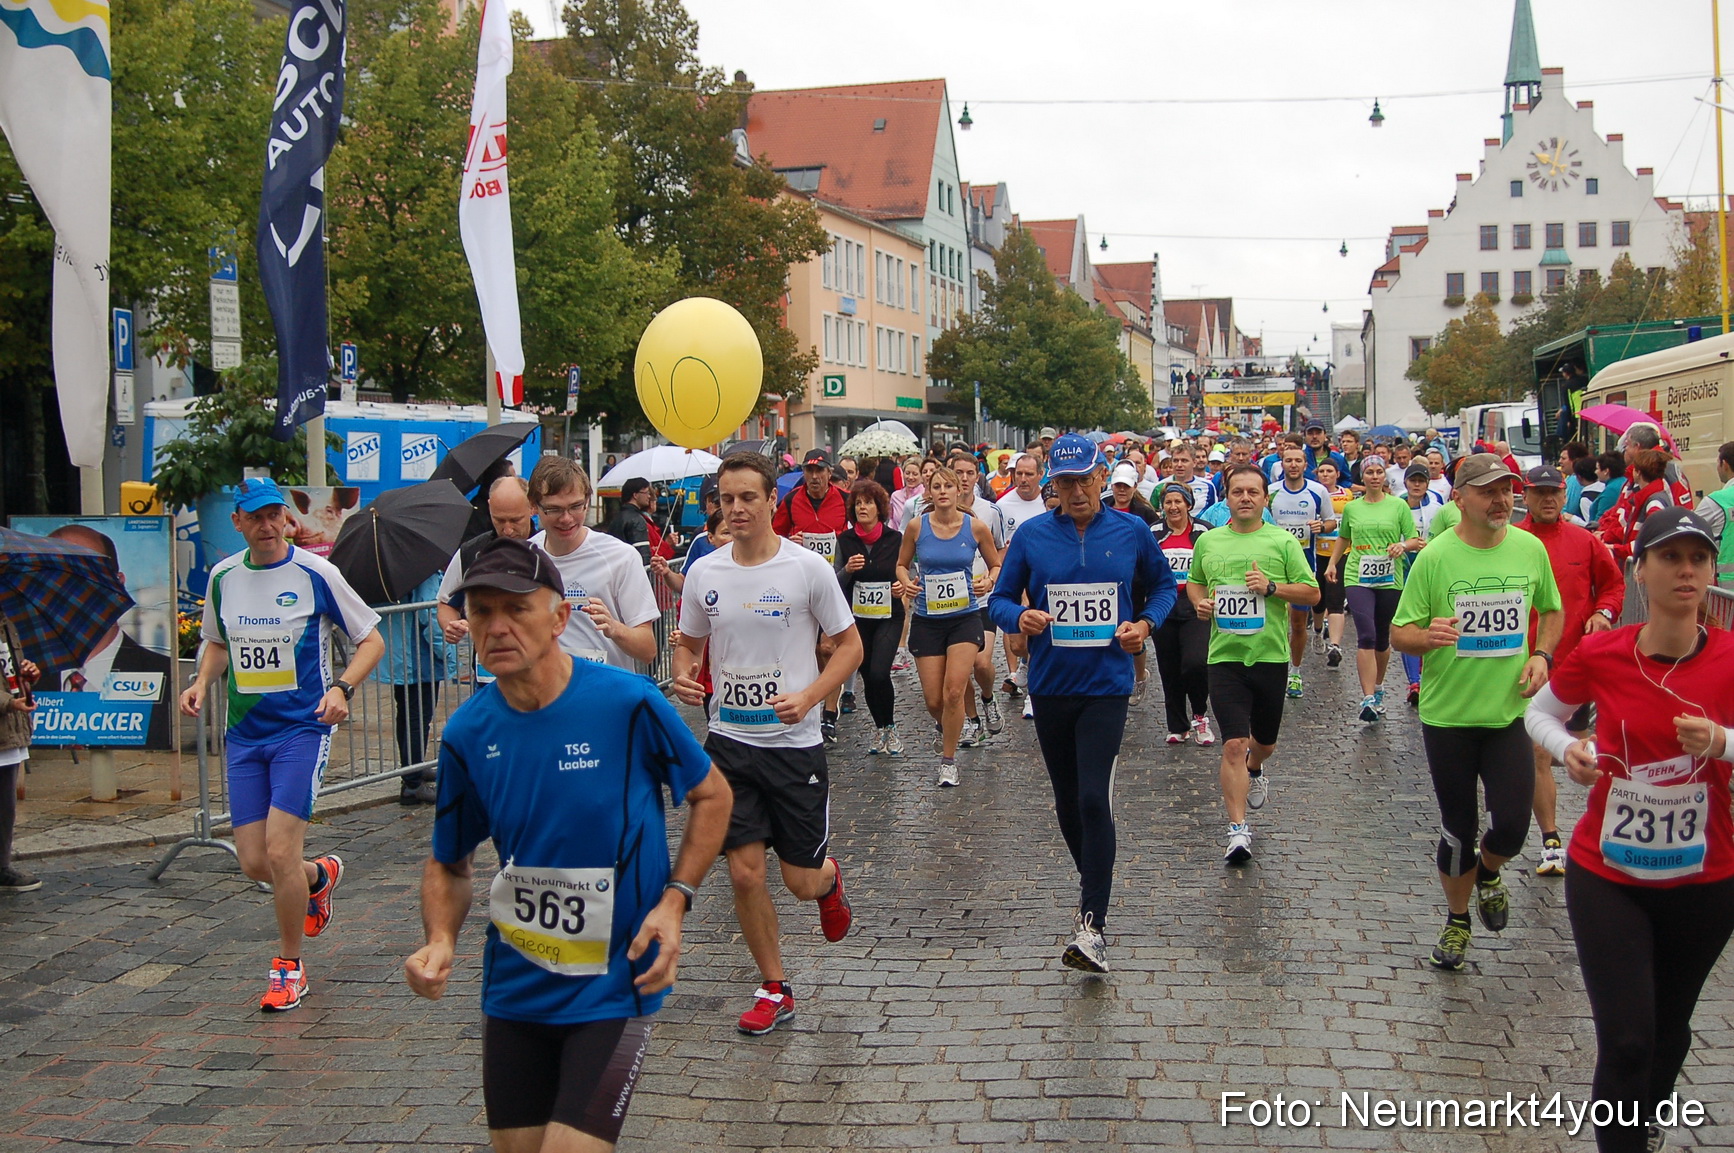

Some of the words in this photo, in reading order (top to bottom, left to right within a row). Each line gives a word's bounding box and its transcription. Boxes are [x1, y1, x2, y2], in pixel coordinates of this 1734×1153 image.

[118, 318, 129, 363] P
[345, 349, 354, 376] P
[827, 378, 842, 394] D
[1233, 395, 1265, 404] START
[1668, 379, 1719, 408] Bayerisches
[1667, 410, 1691, 429] Rotes
[1054, 446, 1082, 457] ITALIA
[810, 542, 832, 555] 293
[1362, 562, 1392, 576] 2397
[937, 583, 955, 599] 26
[859, 592, 884, 605] 542
[936, 601, 959, 609] Daniela
[1481, 599, 1513, 607] Neumarkt
[1056, 598, 1112, 623] 2158
[1218, 597, 1258, 615] 2021
[238, 616, 281, 625] Thomas
[1230, 620, 1247, 628] Horst
[1462, 608, 1519, 633] 2493
[230, 636, 248, 644] PARTL
[248, 636, 280, 644] Neumarkt
[1072, 629, 1095, 638] Hans
[1476, 638, 1507, 649] Robert
[240, 646, 281, 669] 584
[722, 669, 735, 680] PARTL
[736, 672, 771, 681] Neumarkt
[112, 680, 141, 692] CSU
[724, 681, 779, 707] 2638
[36, 697, 64, 707] Albert
[33, 708, 144, 731] FÜRACKER
[729, 712, 774, 723] Sebastian
[486, 751, 501, 759] erima
[565, 743, 590, 756] TSG
[558, 758, 600, 771] Laaber
[1648, 764, 1676, 778] DEHN
[1610, 788, 1641, 802] PARTL
[1644, 795, 1691, 806] Neumarkt
[1612, 804, 1697, 844] 2313
[1624, 850, 1683, 867] Susanne
[532, 877, 590, 891] Neumarkt
[514, 887, 586, 935] 563
[511, 929, 560, 966] Georg
